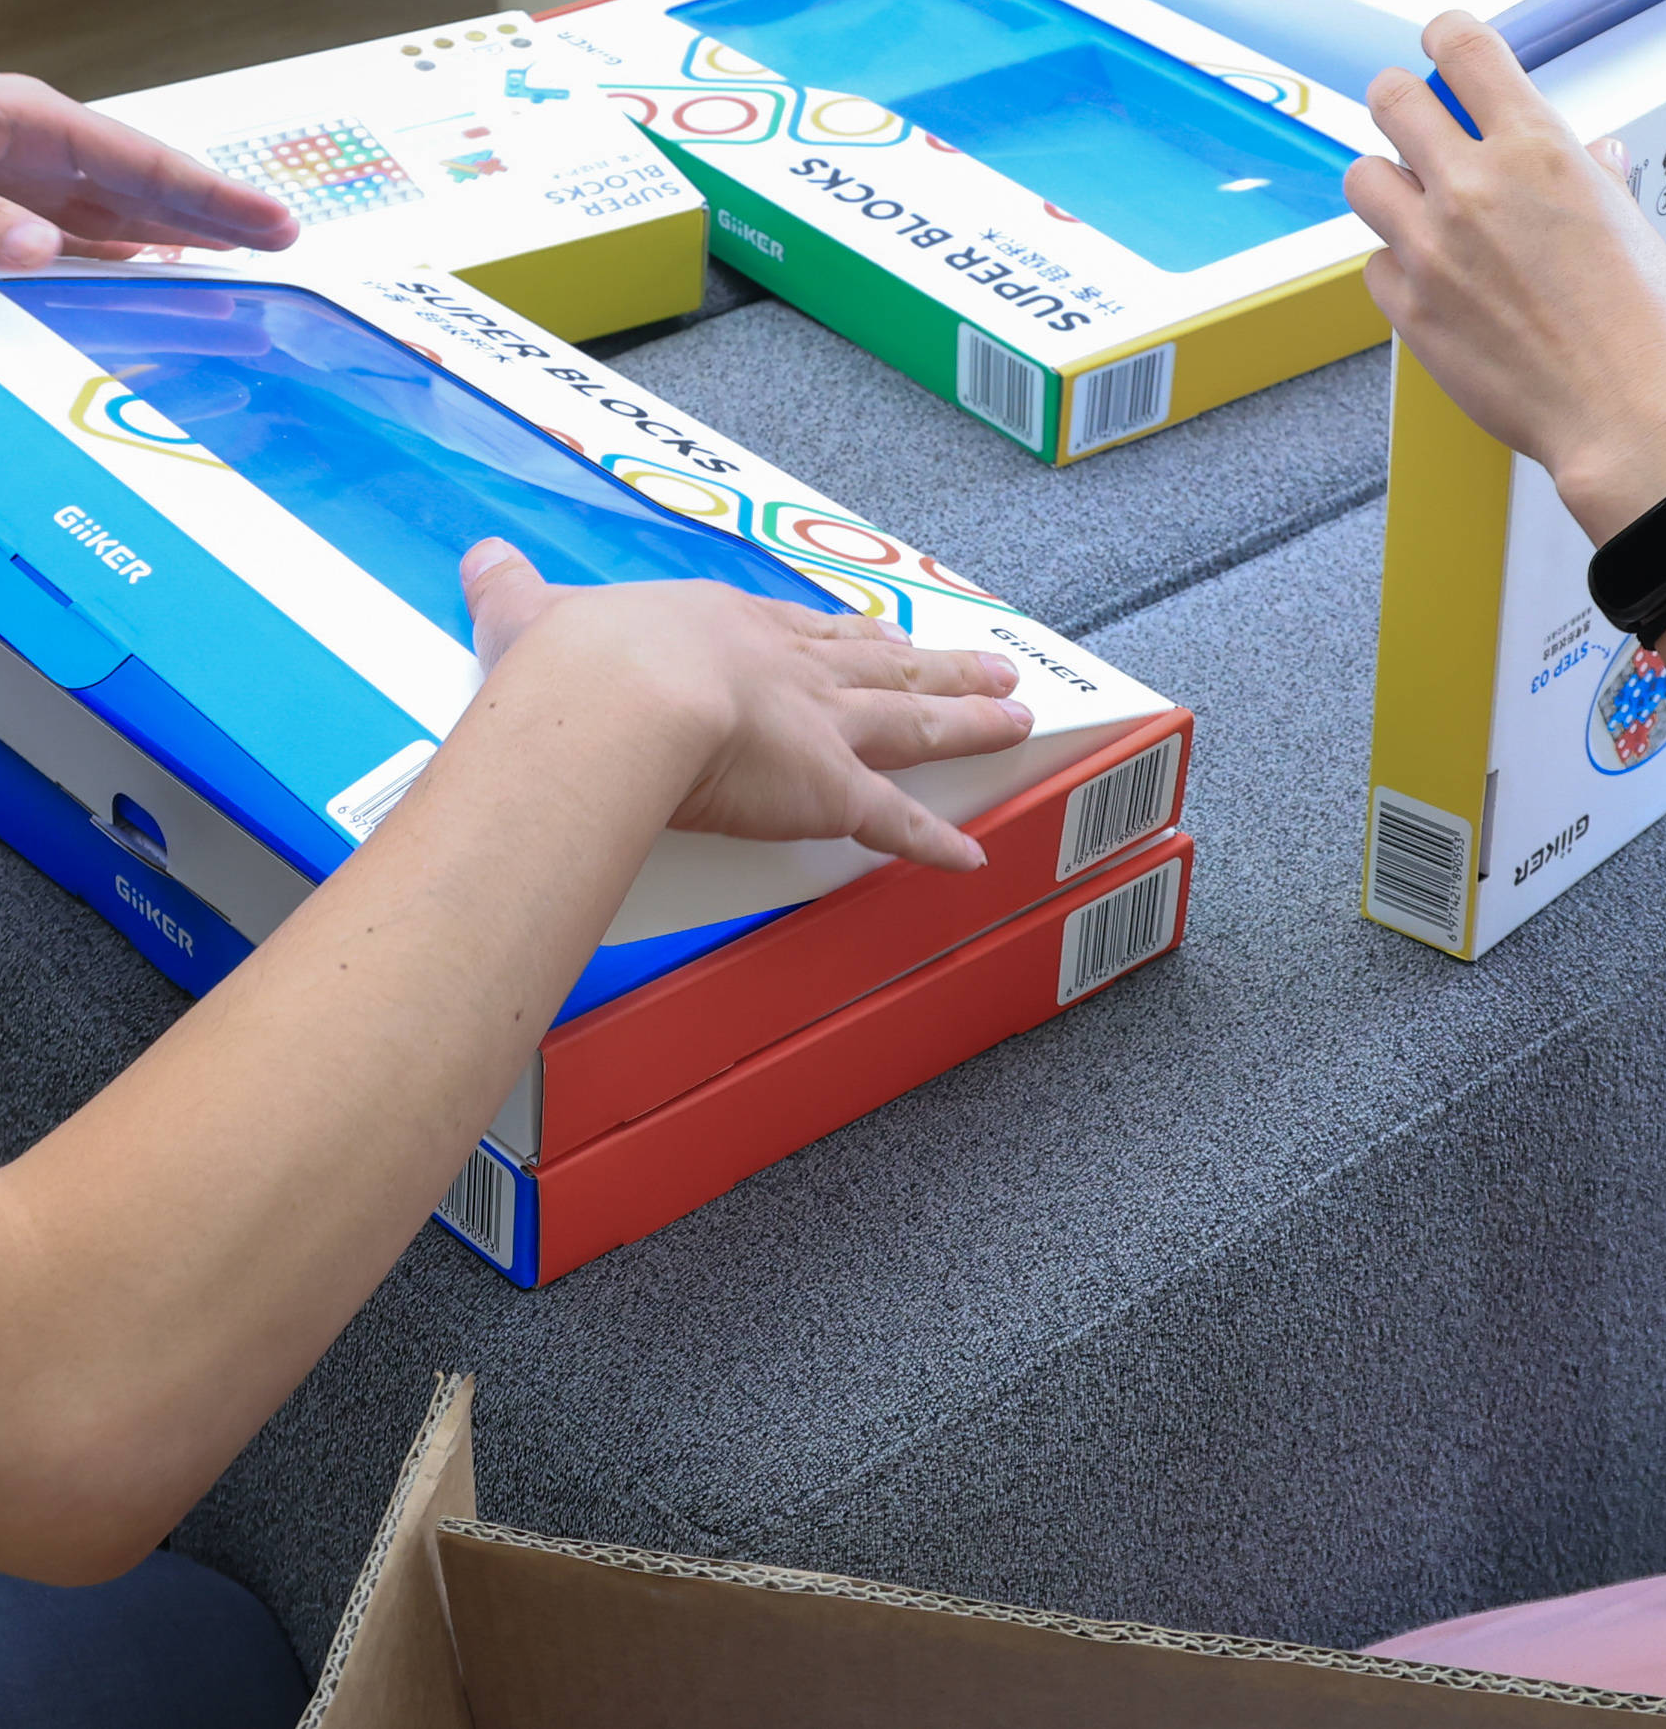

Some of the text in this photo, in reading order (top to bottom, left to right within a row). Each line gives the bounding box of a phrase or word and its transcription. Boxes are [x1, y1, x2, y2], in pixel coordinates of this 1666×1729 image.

[544, 164, 665, 205] BLOCKS
[580, 180, 680, 217] SUPER
[717, 208, 785, 262] GiiKER
[789, 158, 1091, 331] SUPER BLOCKS
[395, 280, 741, 474] SUPER BLOCKS
[53, 504, 152, 585] GiiKER
[990, 628, 1098, 692] GiiKER
[1531, 641, 1589, 694] STEP 03
[1452, 838, 1465, 881] 890553
[1514, 813, 1590, 886] GiiKER
[115, 874, 194, 958] GiiKER
[1449, 883, 1462, 927] 971421
